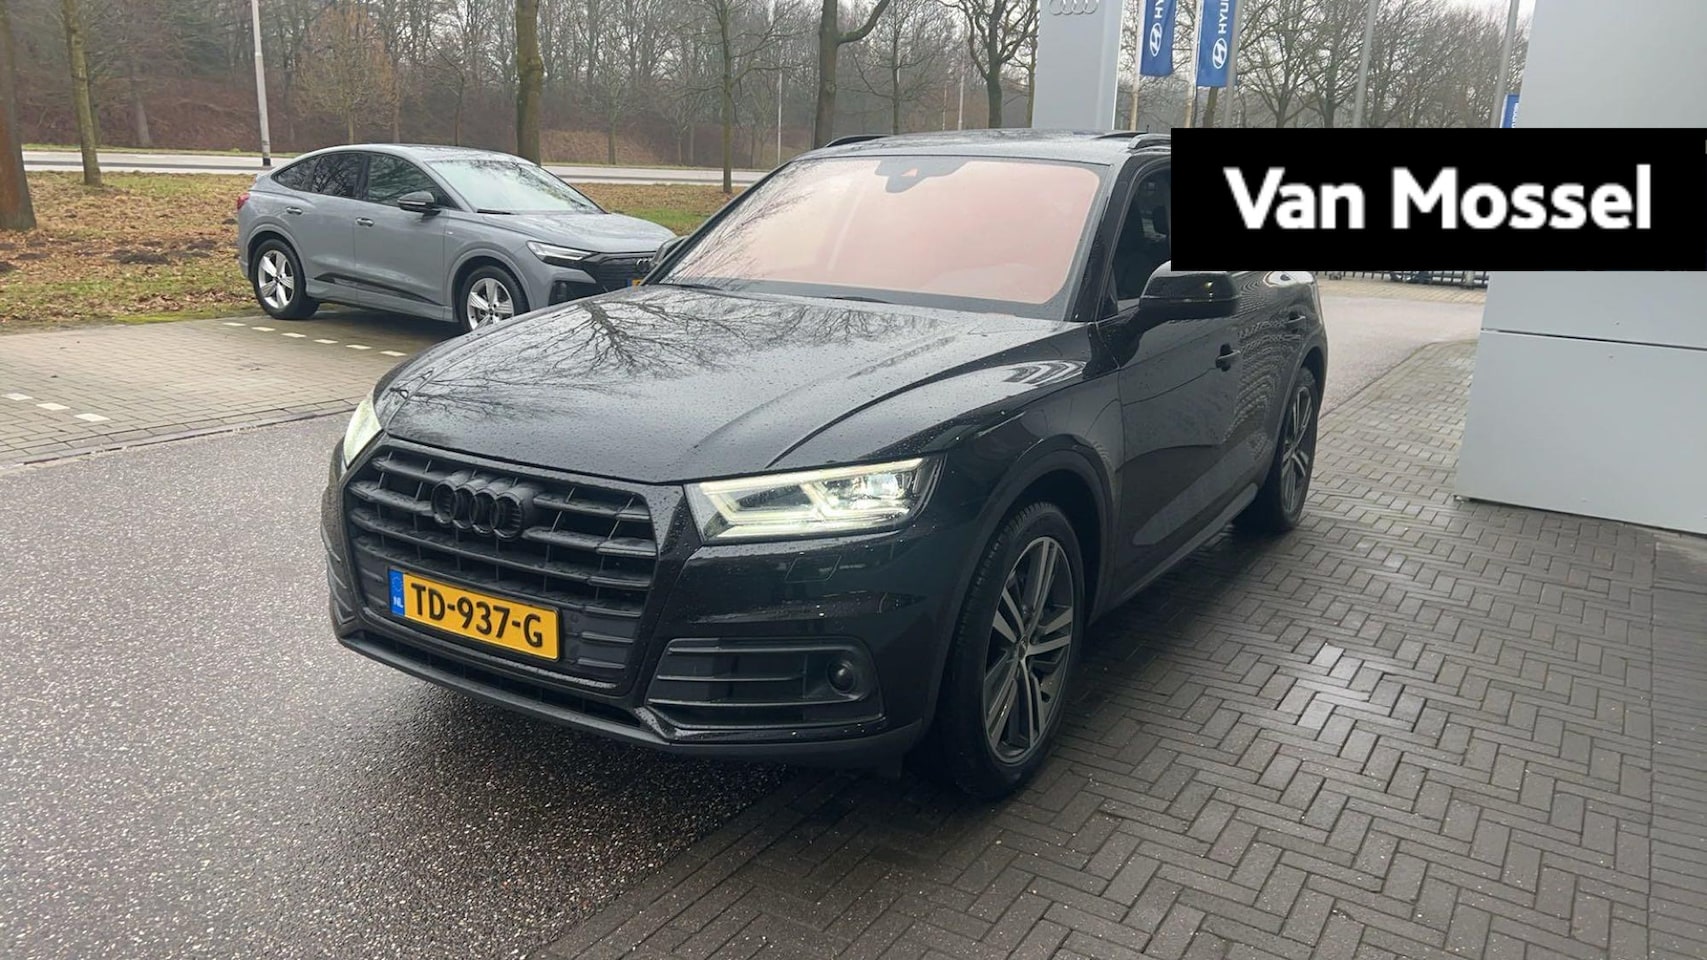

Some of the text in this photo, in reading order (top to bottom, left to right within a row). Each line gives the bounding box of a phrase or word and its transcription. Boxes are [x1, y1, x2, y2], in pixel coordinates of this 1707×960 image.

[1218, 0, 1230, 34] HYU
[392, 596, 404, 609] NL
[410, 582, 544, 648] TD-937-G
